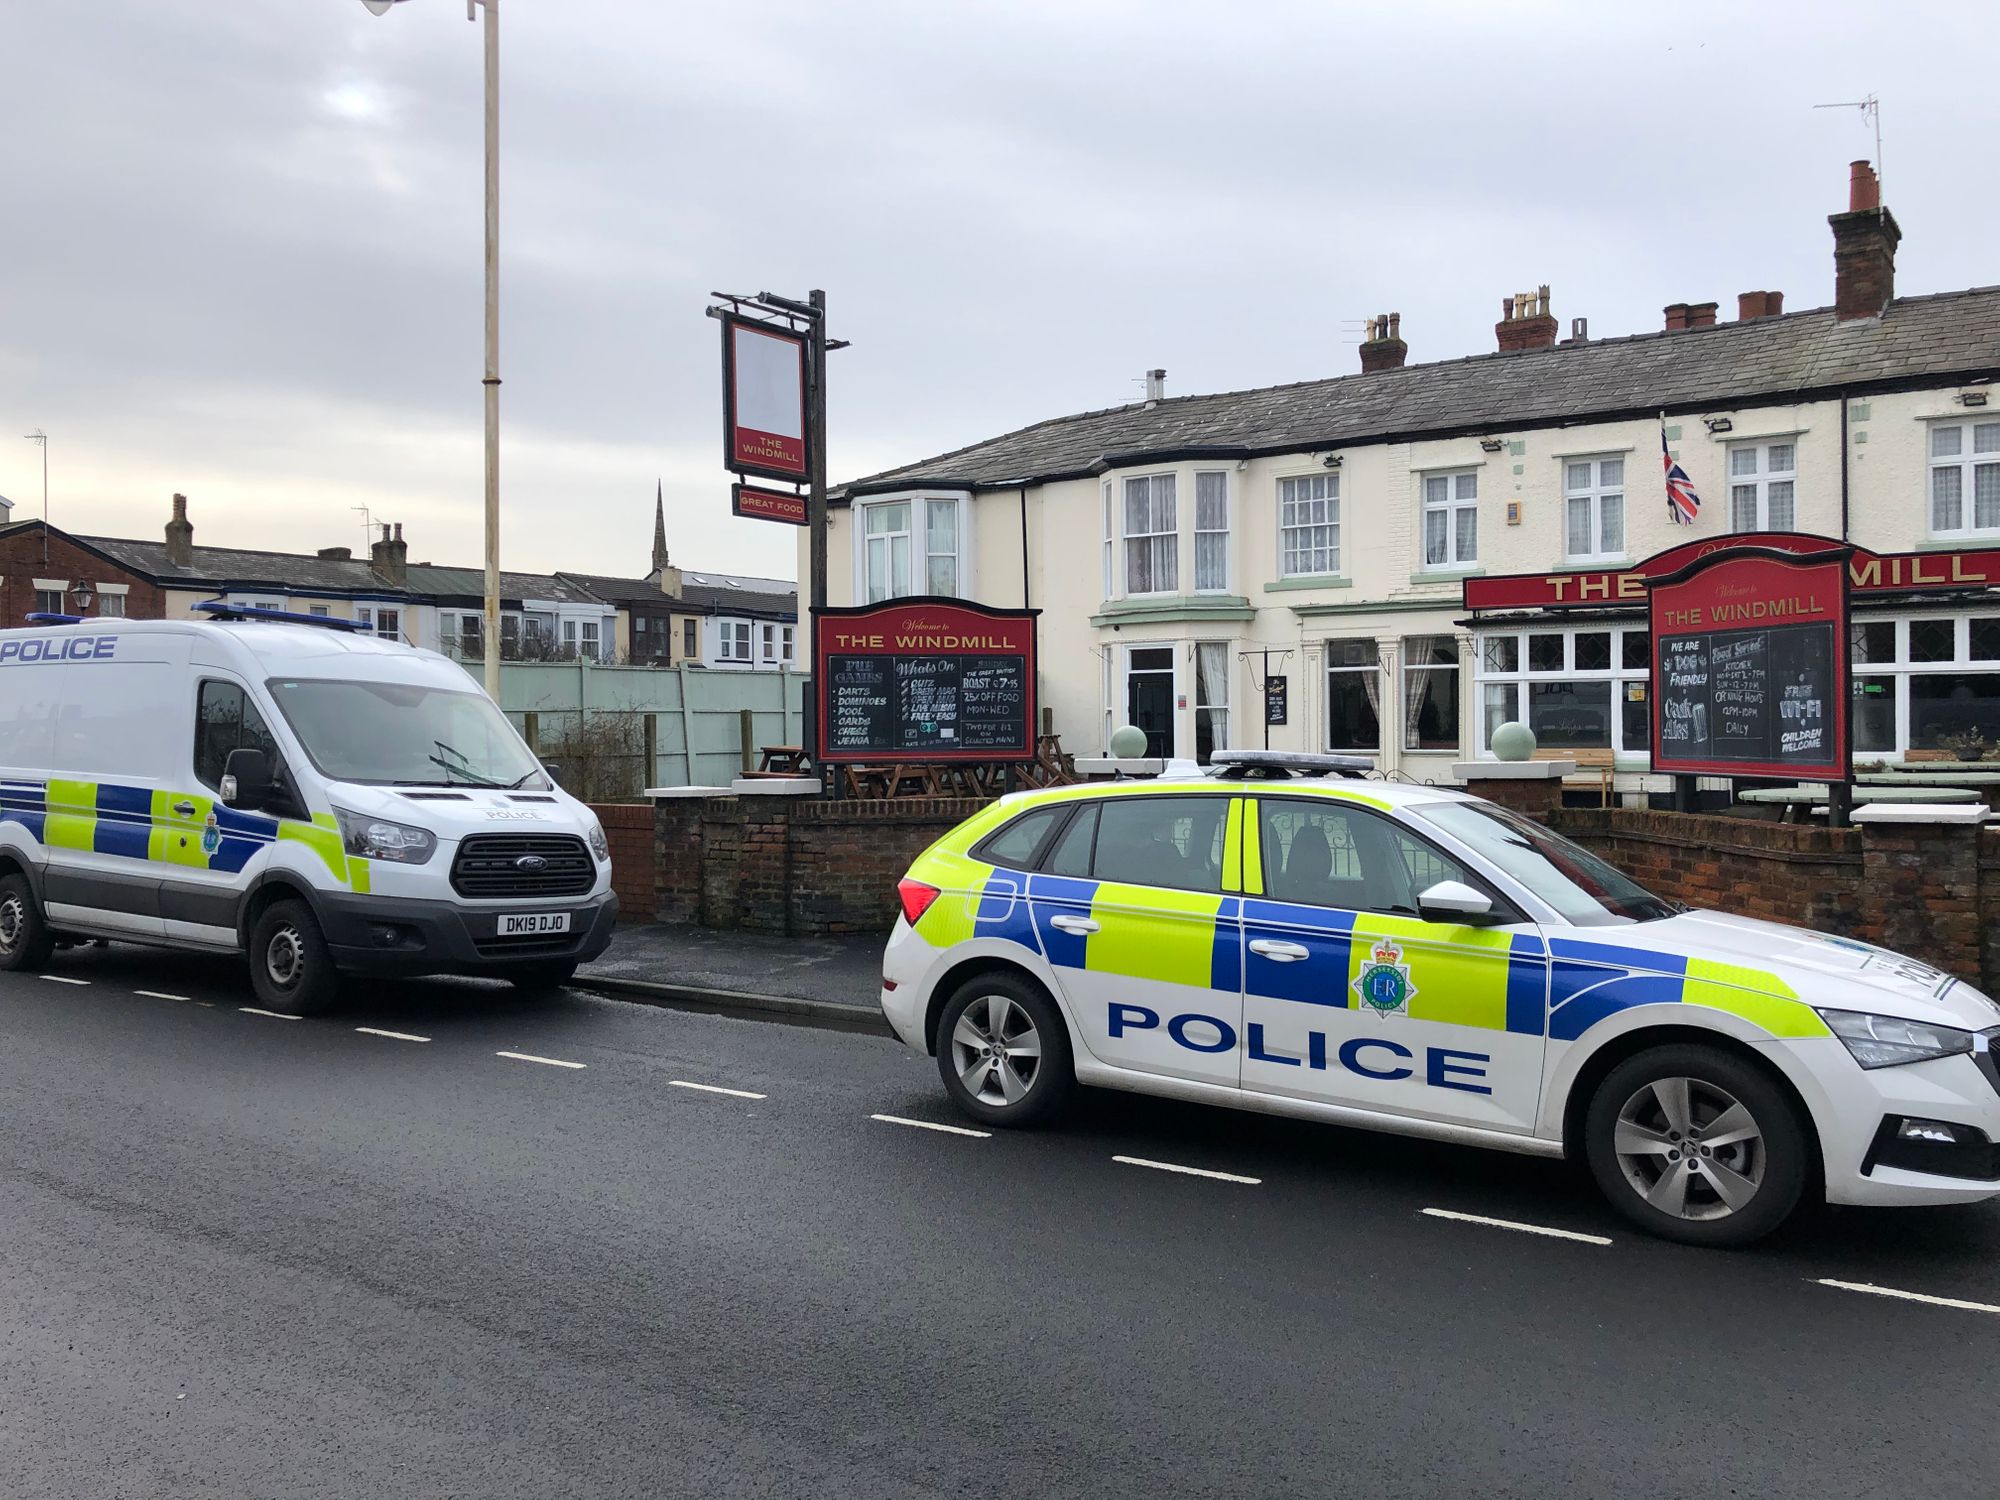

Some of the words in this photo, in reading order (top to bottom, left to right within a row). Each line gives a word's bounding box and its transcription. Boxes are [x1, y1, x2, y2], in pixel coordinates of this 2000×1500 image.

[759, 437, 783, 449] THE
[742, 444, 799, 462] WINDMILL
[740, 496, 774, 509] GREAT
[777, 502, 804, 514] FOOD
[1546, 574, 1646, 600] THE
[1664, 608, 1701, 625] THE
[1711, 596, 1824, 623] WINDMILL
[902, 619, 940, 632] Welcome
[941, 623, 950, 631] to
[835, 635, 884, 648] THE
[895, 635, 1016, 649] WINDMILL
[1671, 642, 1684, 652] WE
[1684, 641, 1700, 651] ARE
[0, 636, 118, 661] POLICE
[845, 660, 874, 672] PUB
[896, 660, 936, 677] Whats
[938, 660, 956, 673] On
[1673, 654, 1697, 671] DOG
[835, 672, 883, 683] GAMES
[962, 677, 991, 689] ROAST
[1670, 672, 1708, 687] FRIENDLY
[910, 679, 935, 689] QUIZ
[838, 687, 870, 696] DARTS
[981, 692, 996, 702] OFF
[997, 693, 1020, 703] FOOD
[838, 697, 887, 706] DOMINOES
[911, 695, 934, 704] OPEN
[838, 707, 865, 716] POOL
[910, 704, 930, 712] LIVE
[930, 703, 957, 712] MUSIC
[1664, 696, 1693, 719] Cask
[838, 717, 871, 726] CARDS
[910, 712, 931, 721] FREE
[838, 727, 868, 736] CHESS
[965, 723, 982, 731] TWO
[983, 723, 996, 731] FOR
[1726, 722, 1749, 736] DAILY
[1781, 727, 1823, 743] CHILDREN
[1781, 738, 1822, 754] WELCOME
[486, 811, 542, 820] POLICE
[507, 917, 536, 932] DK19
[539, 916, 563, 931] DJO
[1371, 999, 1396, 1009] POLICE
[1108, 1002, 1493, 1095] POLICE
